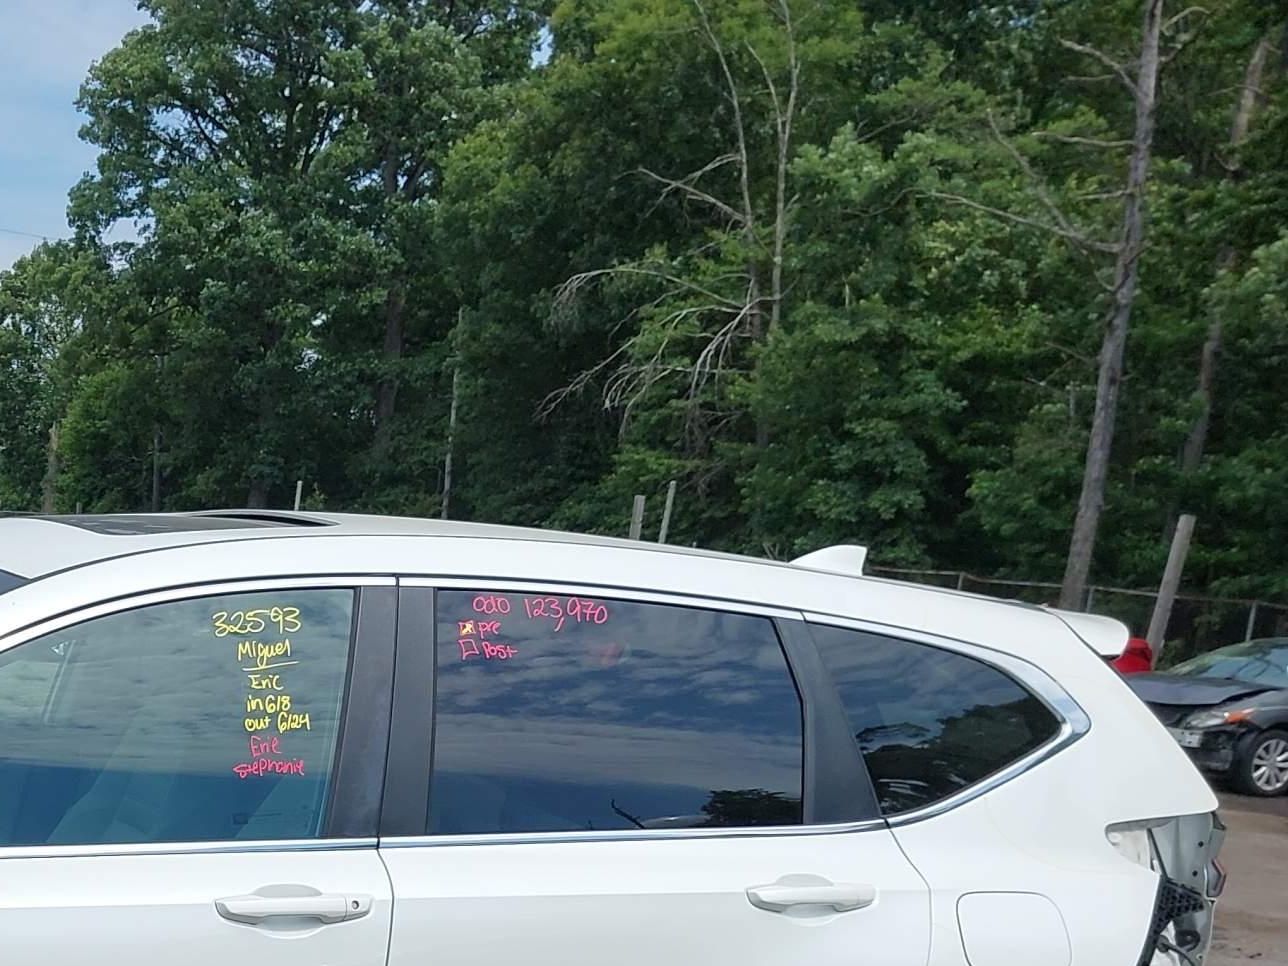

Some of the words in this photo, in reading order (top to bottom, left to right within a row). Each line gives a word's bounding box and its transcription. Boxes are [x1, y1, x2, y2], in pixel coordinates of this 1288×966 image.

[212, 606, 302, 637] 32593
[523, 597, 608, 632] 123,970
[237, 638, 291, 667] Miguel
[246, 694, 264, 713] in
[244, 715, 272, 732] out
